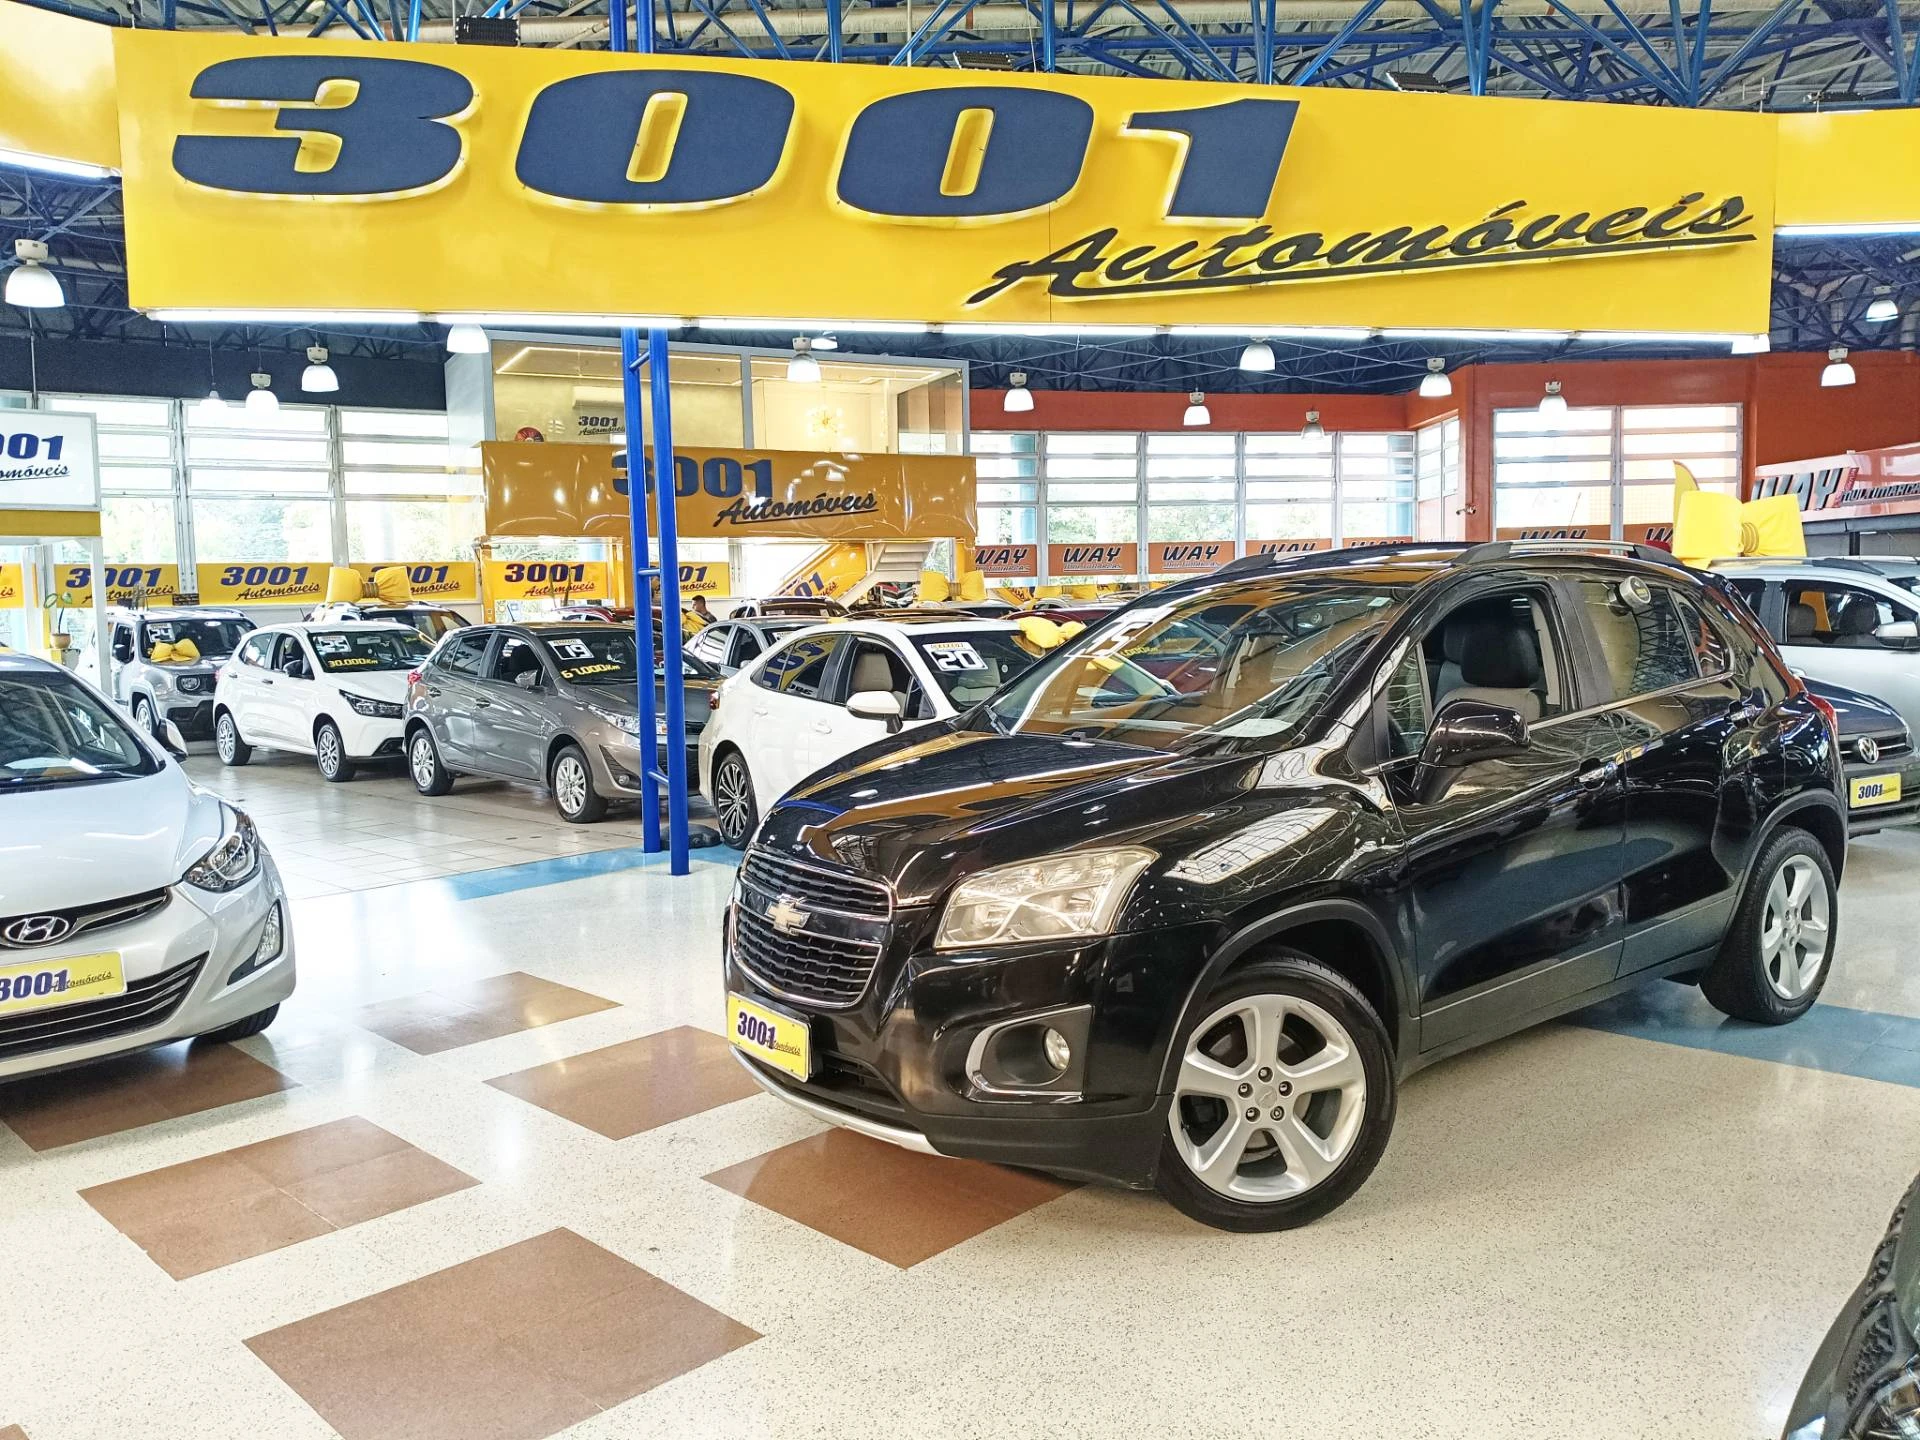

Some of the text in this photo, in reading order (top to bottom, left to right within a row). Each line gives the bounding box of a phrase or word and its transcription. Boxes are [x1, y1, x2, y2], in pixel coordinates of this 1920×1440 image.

[172, 55, 1299, 219] 3001
[965, 191, 1757, 305] Automóveis
[578, 416, 618, 427] 3001
[0, 433, 64, 460] 01
[612, 456, 773, 499] 3001
[713, 491, 879, 527] Automóveis
[1063, 546, 1121, 563] WAY
[1163, 545, 1219, 561] WAY
[220, 565, 309, 586] 3001
[504, 563, 585, 583] 3001
[235, 582, 320, 601] Automóveis
[937, 650, 985, 669] 20
[1858, 784, 1883, 799] 3001
[737, 1011, 776, 1050] 3001
